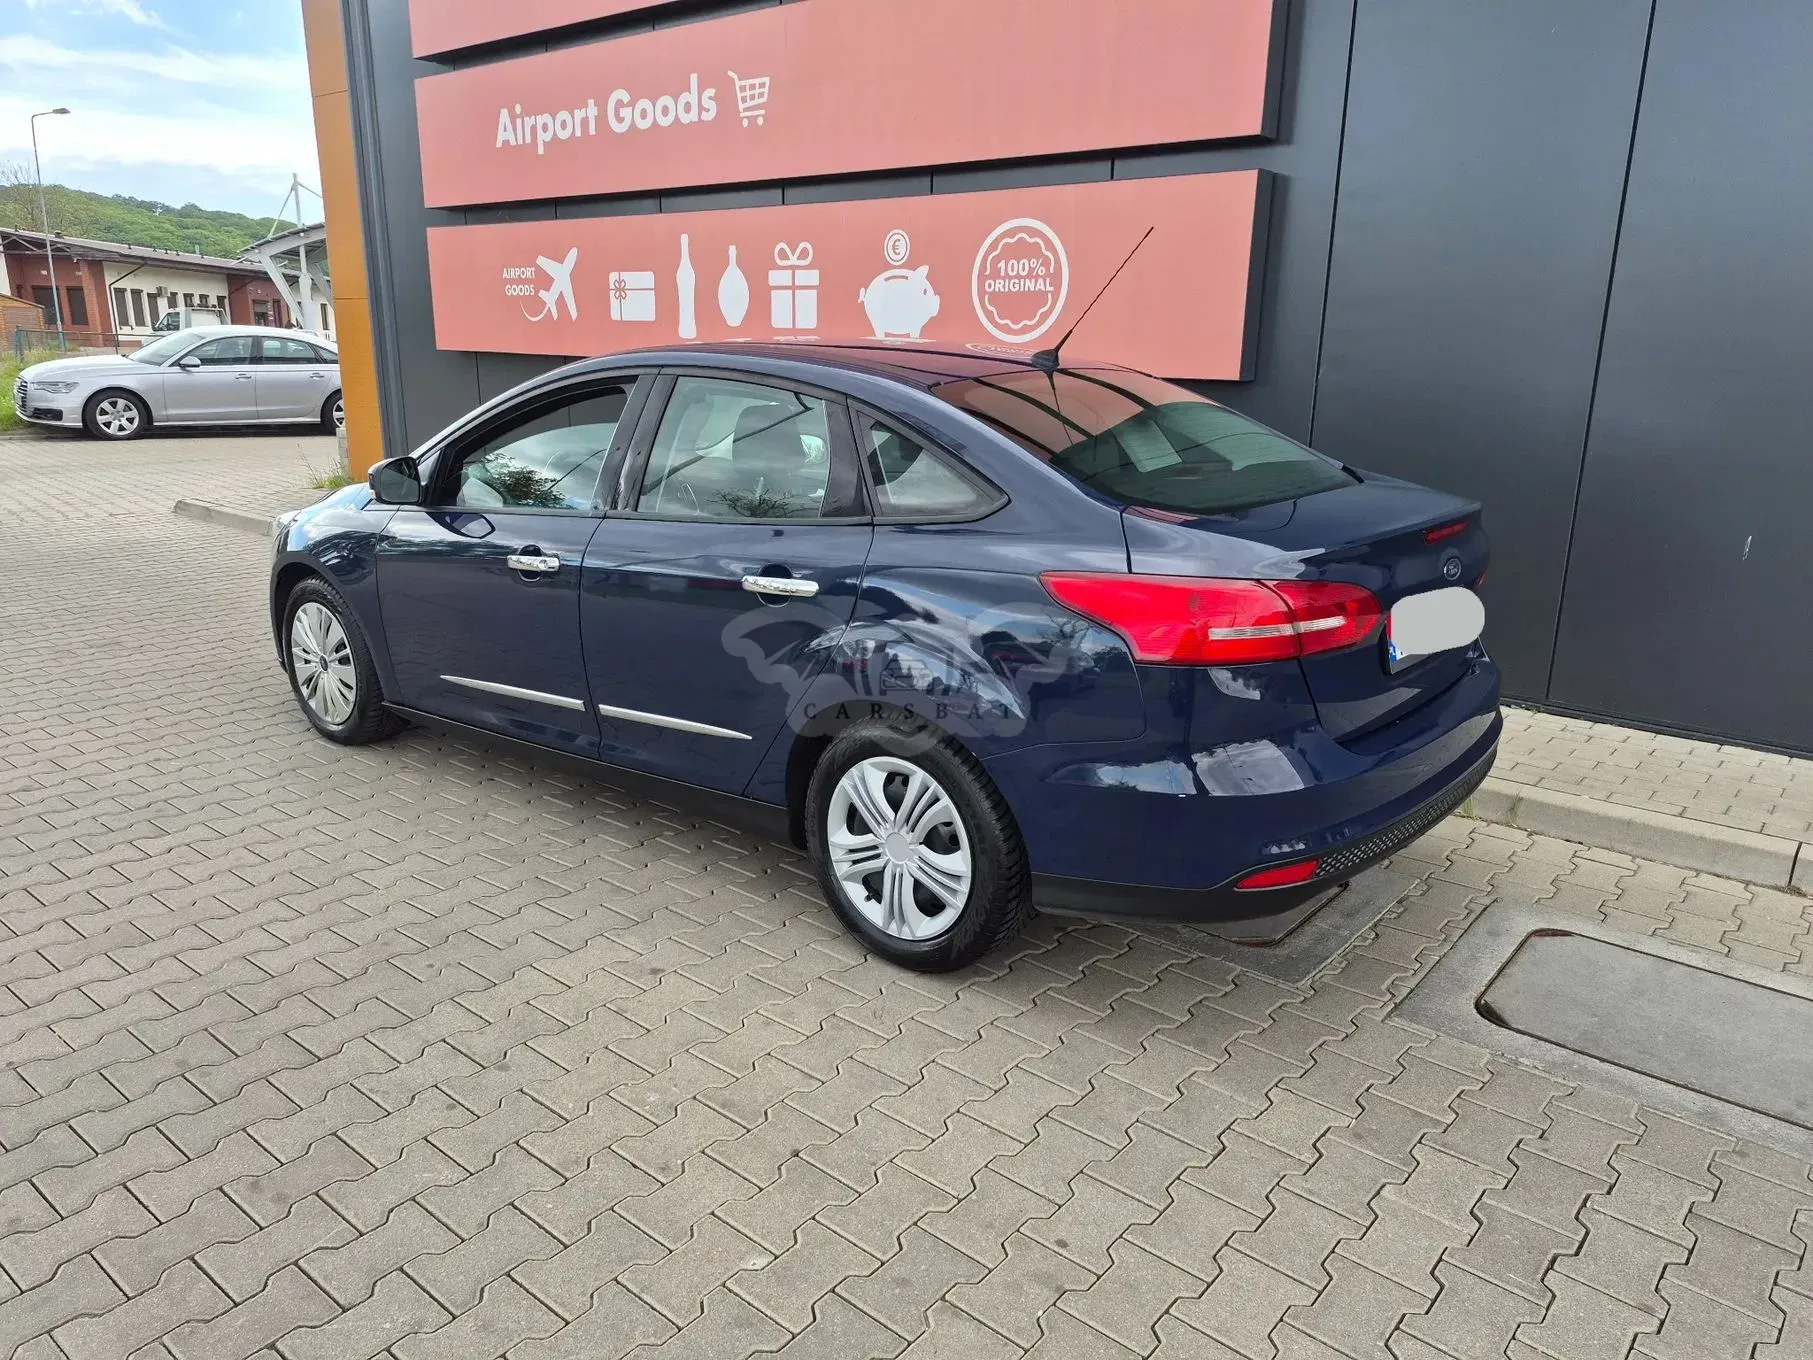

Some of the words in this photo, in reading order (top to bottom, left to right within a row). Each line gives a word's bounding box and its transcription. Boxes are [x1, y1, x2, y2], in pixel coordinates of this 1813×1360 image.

[495, 99, 598, 155] Airport
[607, 73, 717, 133] Goods
[502, 267, 535, 279] AIRPORT
[997, 258, 1045, 277] 100%
[505, 284, 535, 296] GOODS
[985, 278, 1054, 293] ORIGINAL
